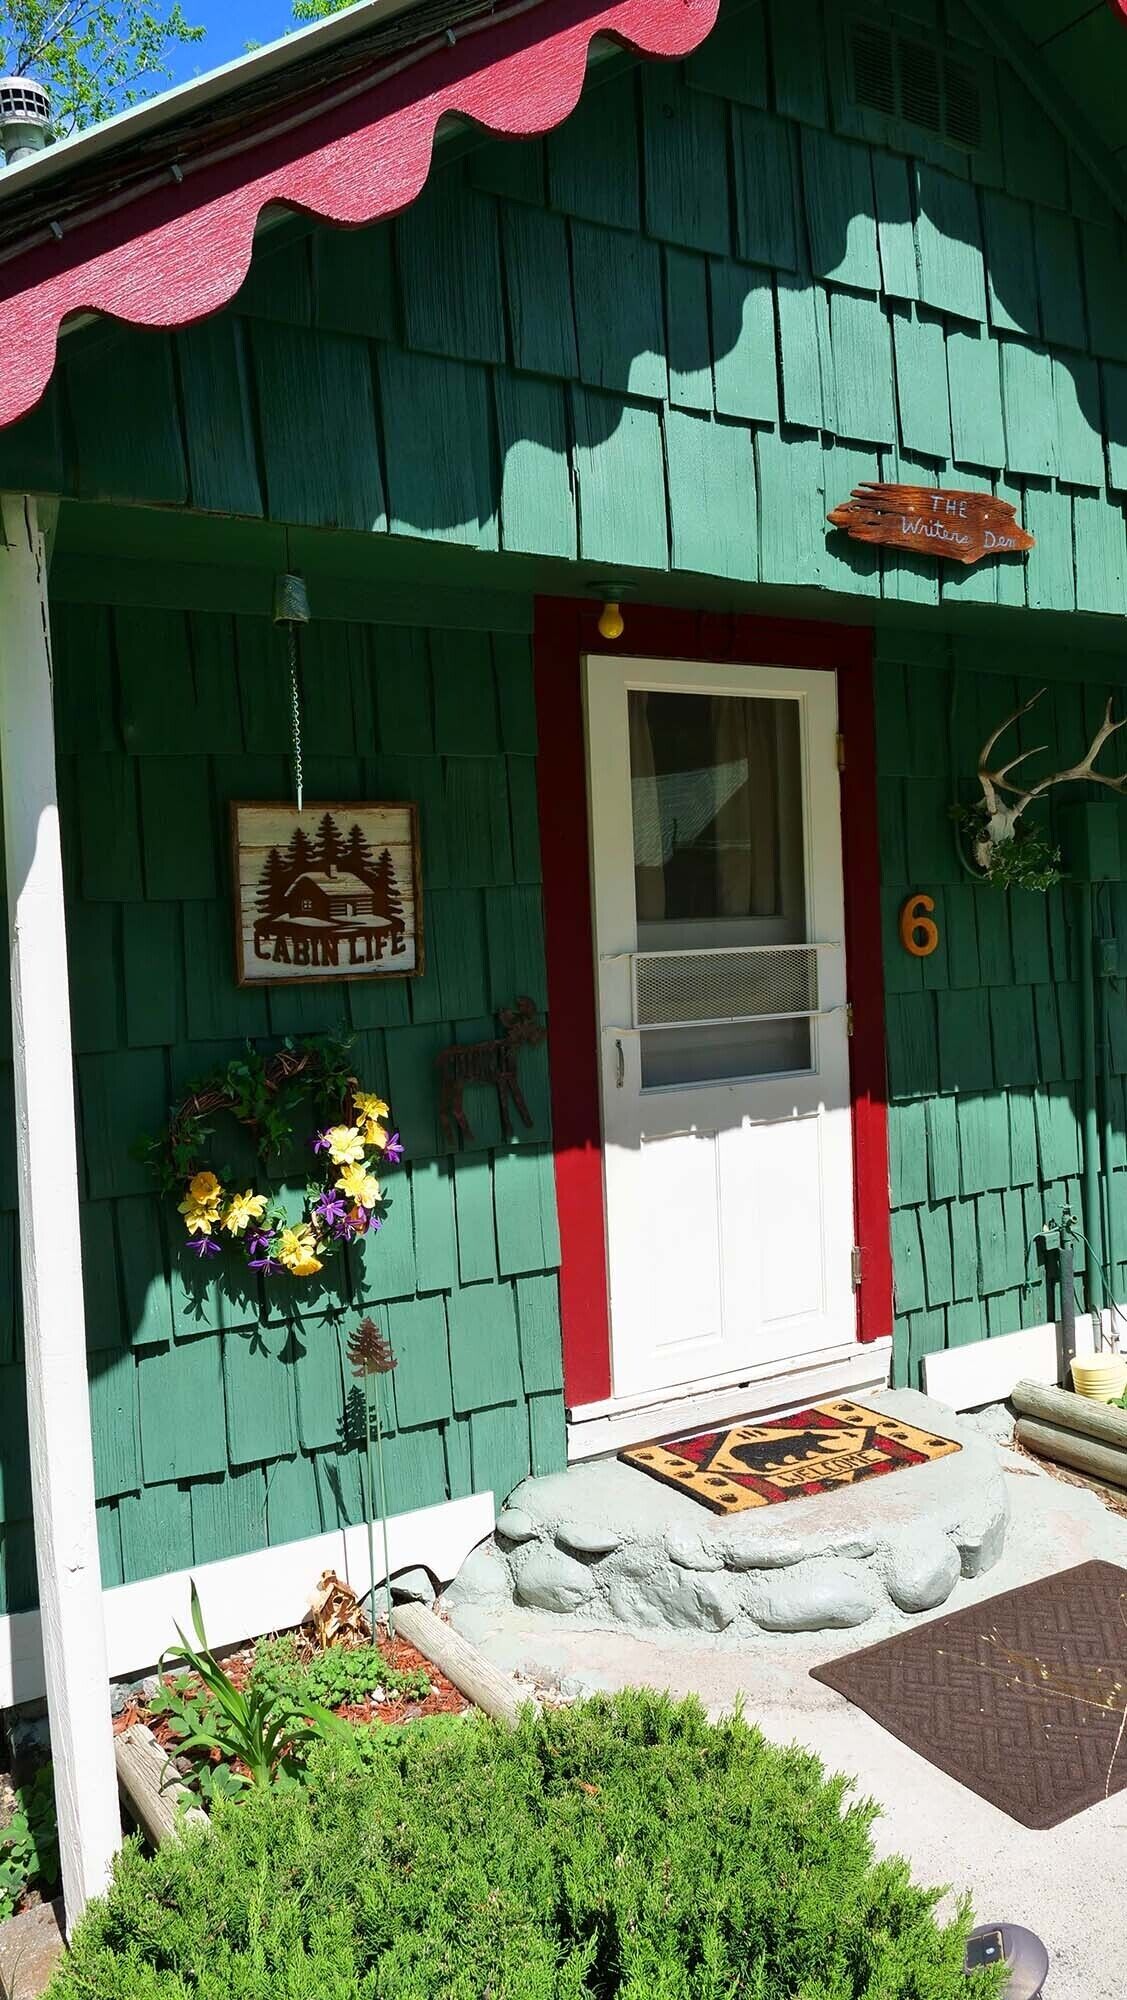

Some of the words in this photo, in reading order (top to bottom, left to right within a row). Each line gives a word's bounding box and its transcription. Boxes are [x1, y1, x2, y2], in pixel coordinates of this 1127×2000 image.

[931, 496, 968, 518] THE
[984, 531, 1016, 548] Den
[903, 895, 938, 955] 6
[254, 928, 338, 966] CABIN
[350, 928, 406, 965] LIFE
[778, 1452, 880, 1483] WELCOME
